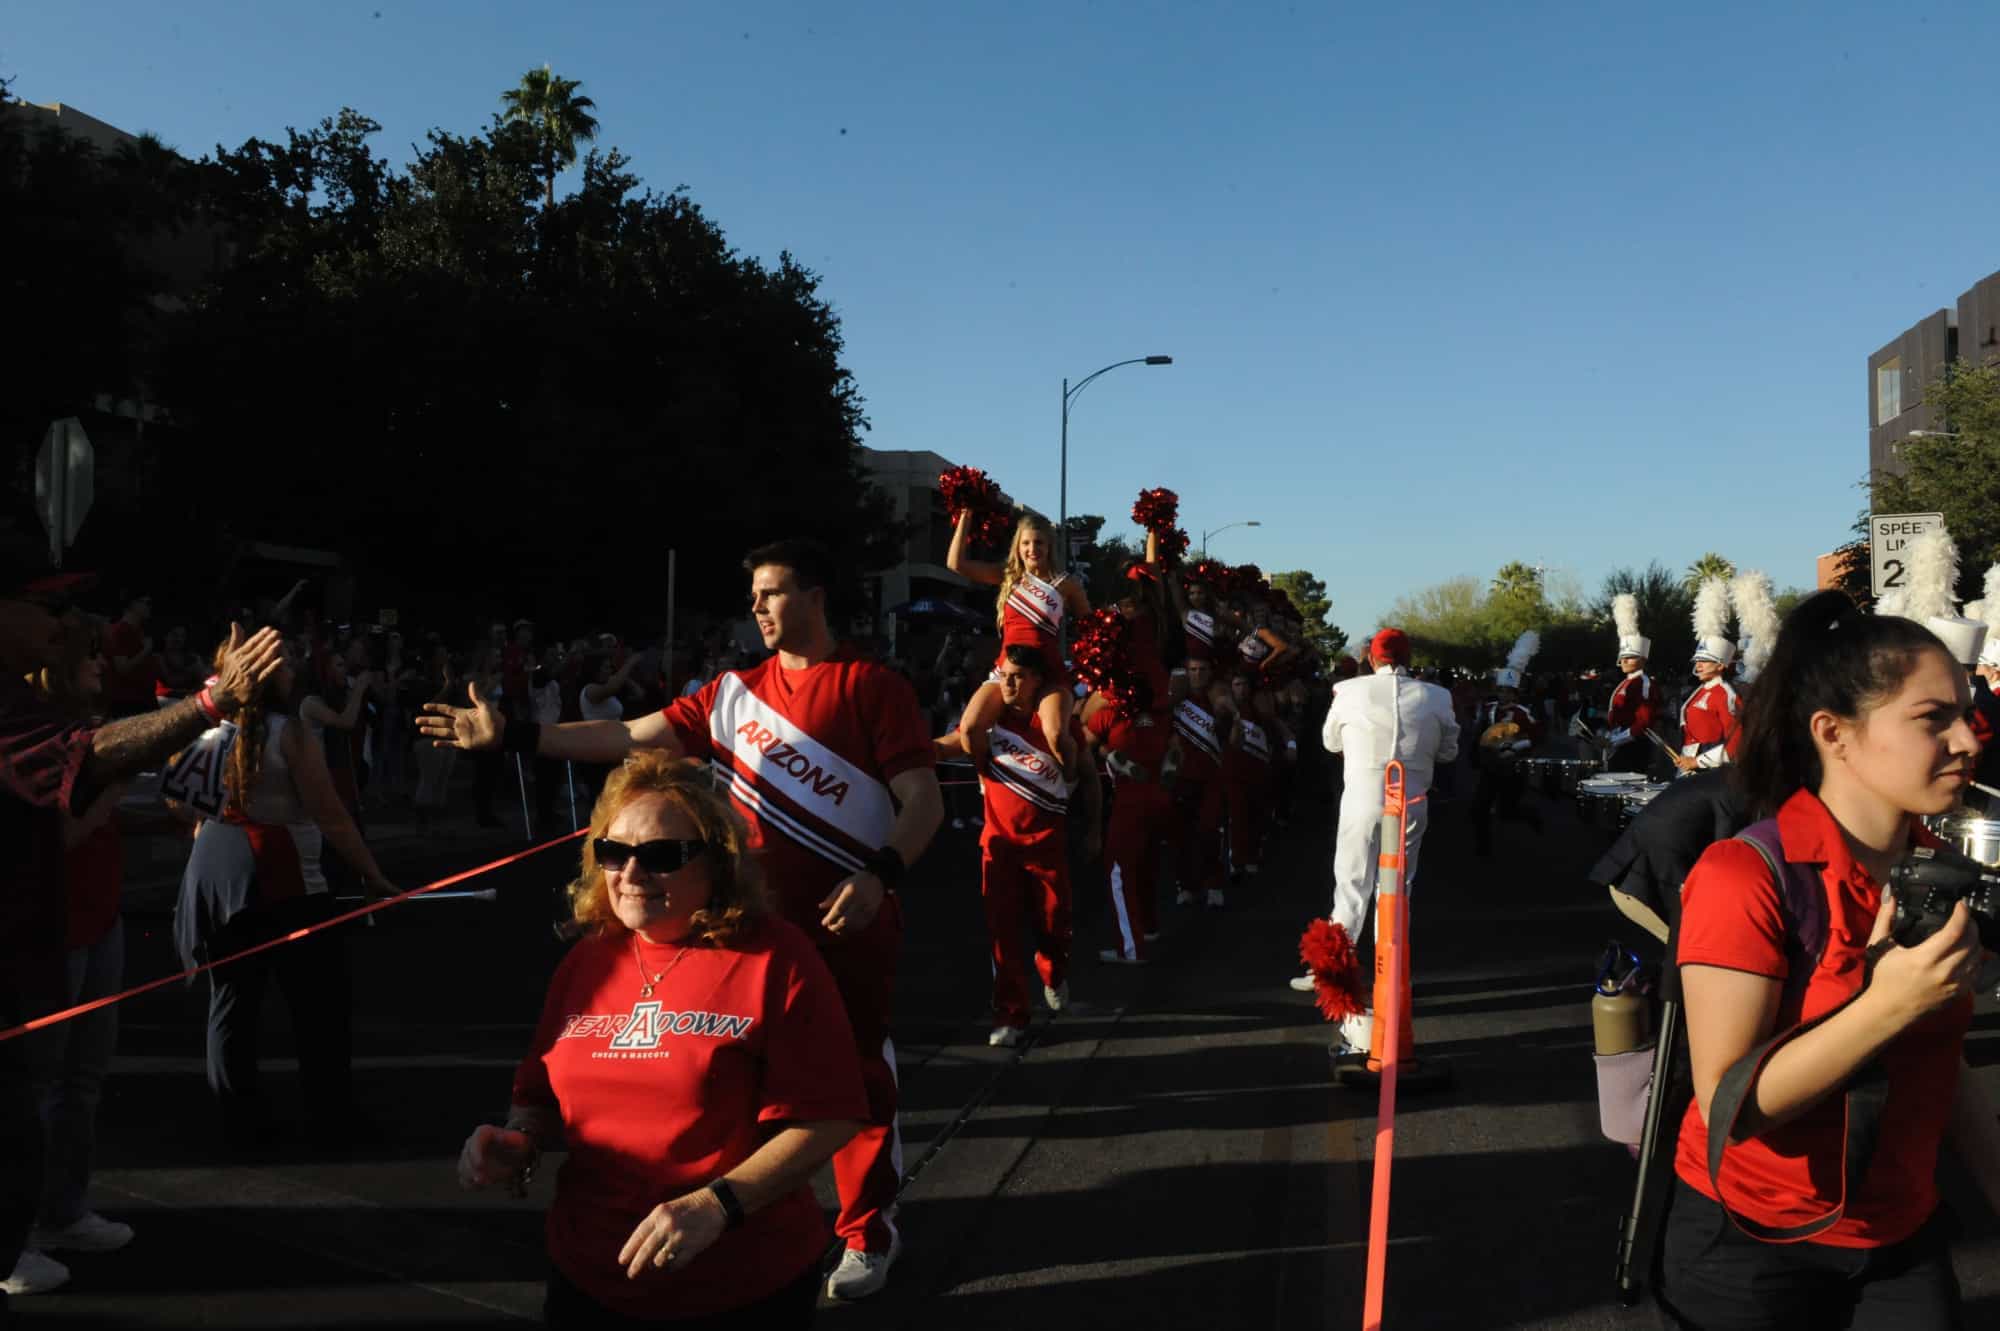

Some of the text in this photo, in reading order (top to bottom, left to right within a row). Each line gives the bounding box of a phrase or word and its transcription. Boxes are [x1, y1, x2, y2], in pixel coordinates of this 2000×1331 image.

[1880, 521, 1932, 535] SPEE
[737, 720, 849, 806] ARIZONA
[609, 1001, 663, 1050] A
[657, 1011, 754, 1038] DOWN
